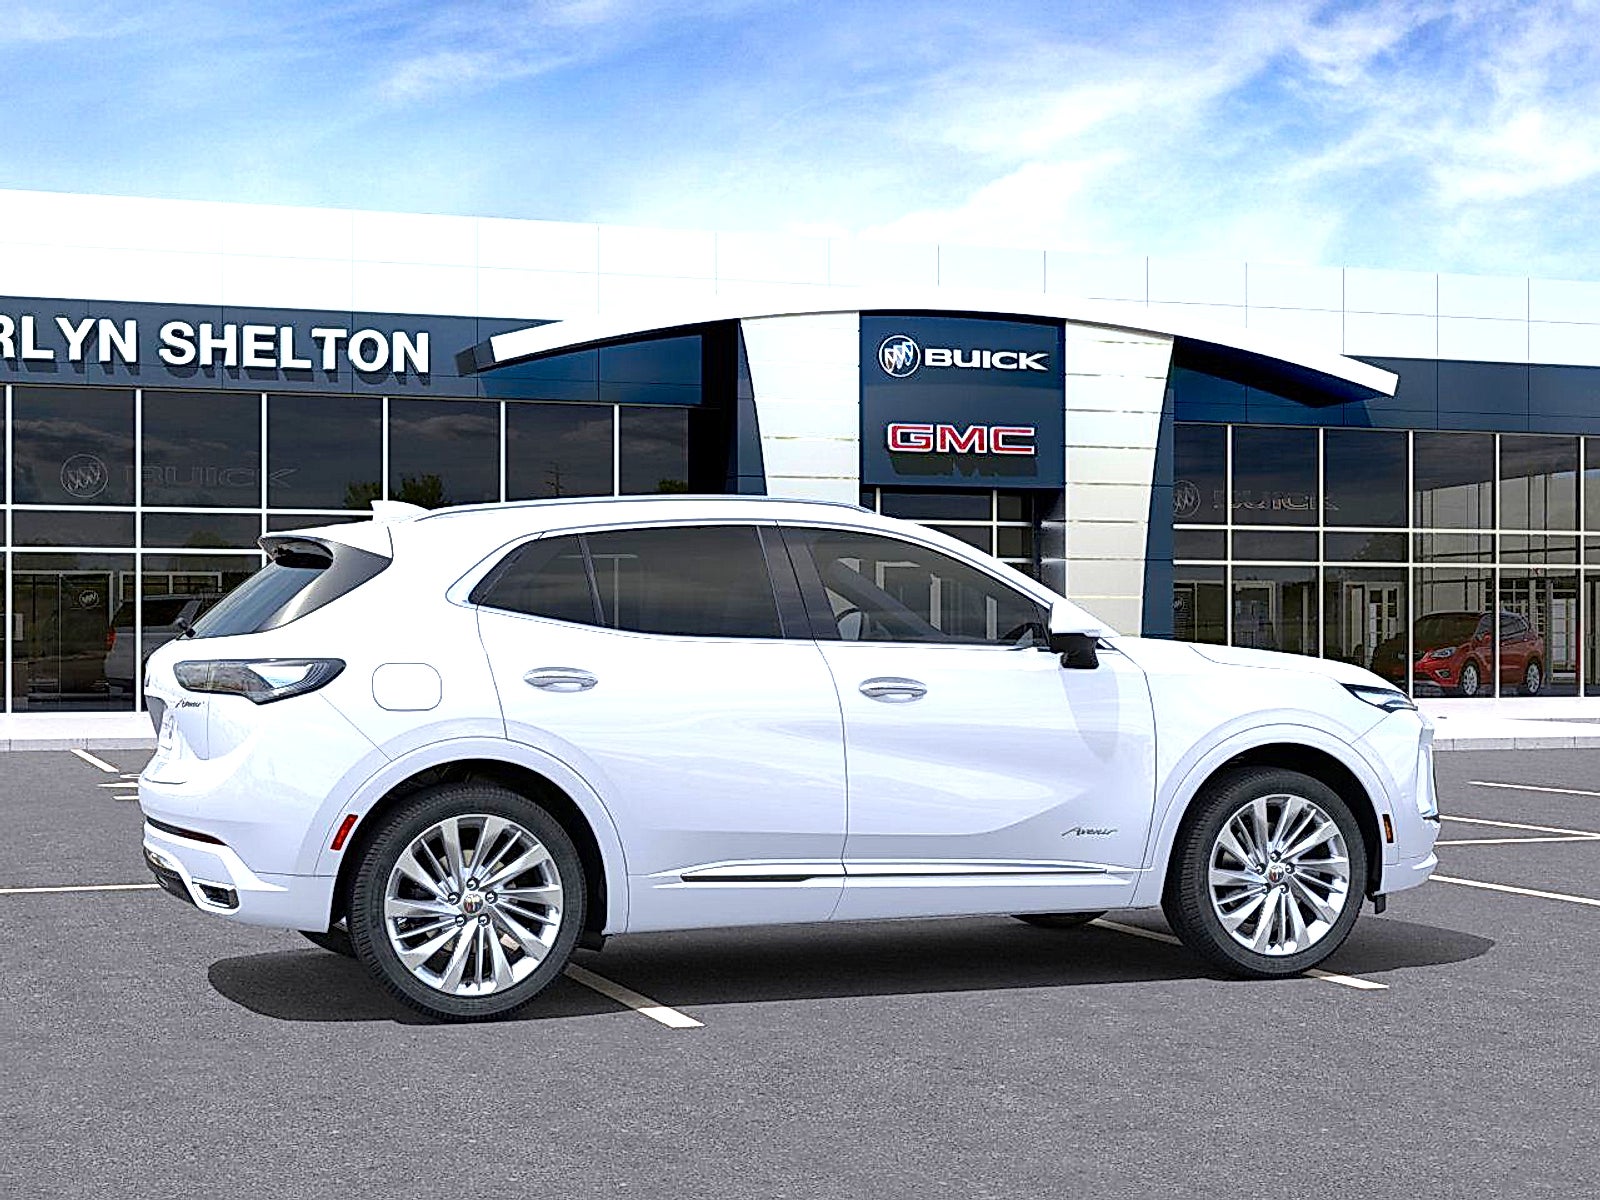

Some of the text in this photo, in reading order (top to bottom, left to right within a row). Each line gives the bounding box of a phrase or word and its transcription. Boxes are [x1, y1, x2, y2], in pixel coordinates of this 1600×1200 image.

[158, 320, 429, 373] SHELTON
[924, 348, 1050, 371] BUICK
[887, 423, 1035, 455] GMC
